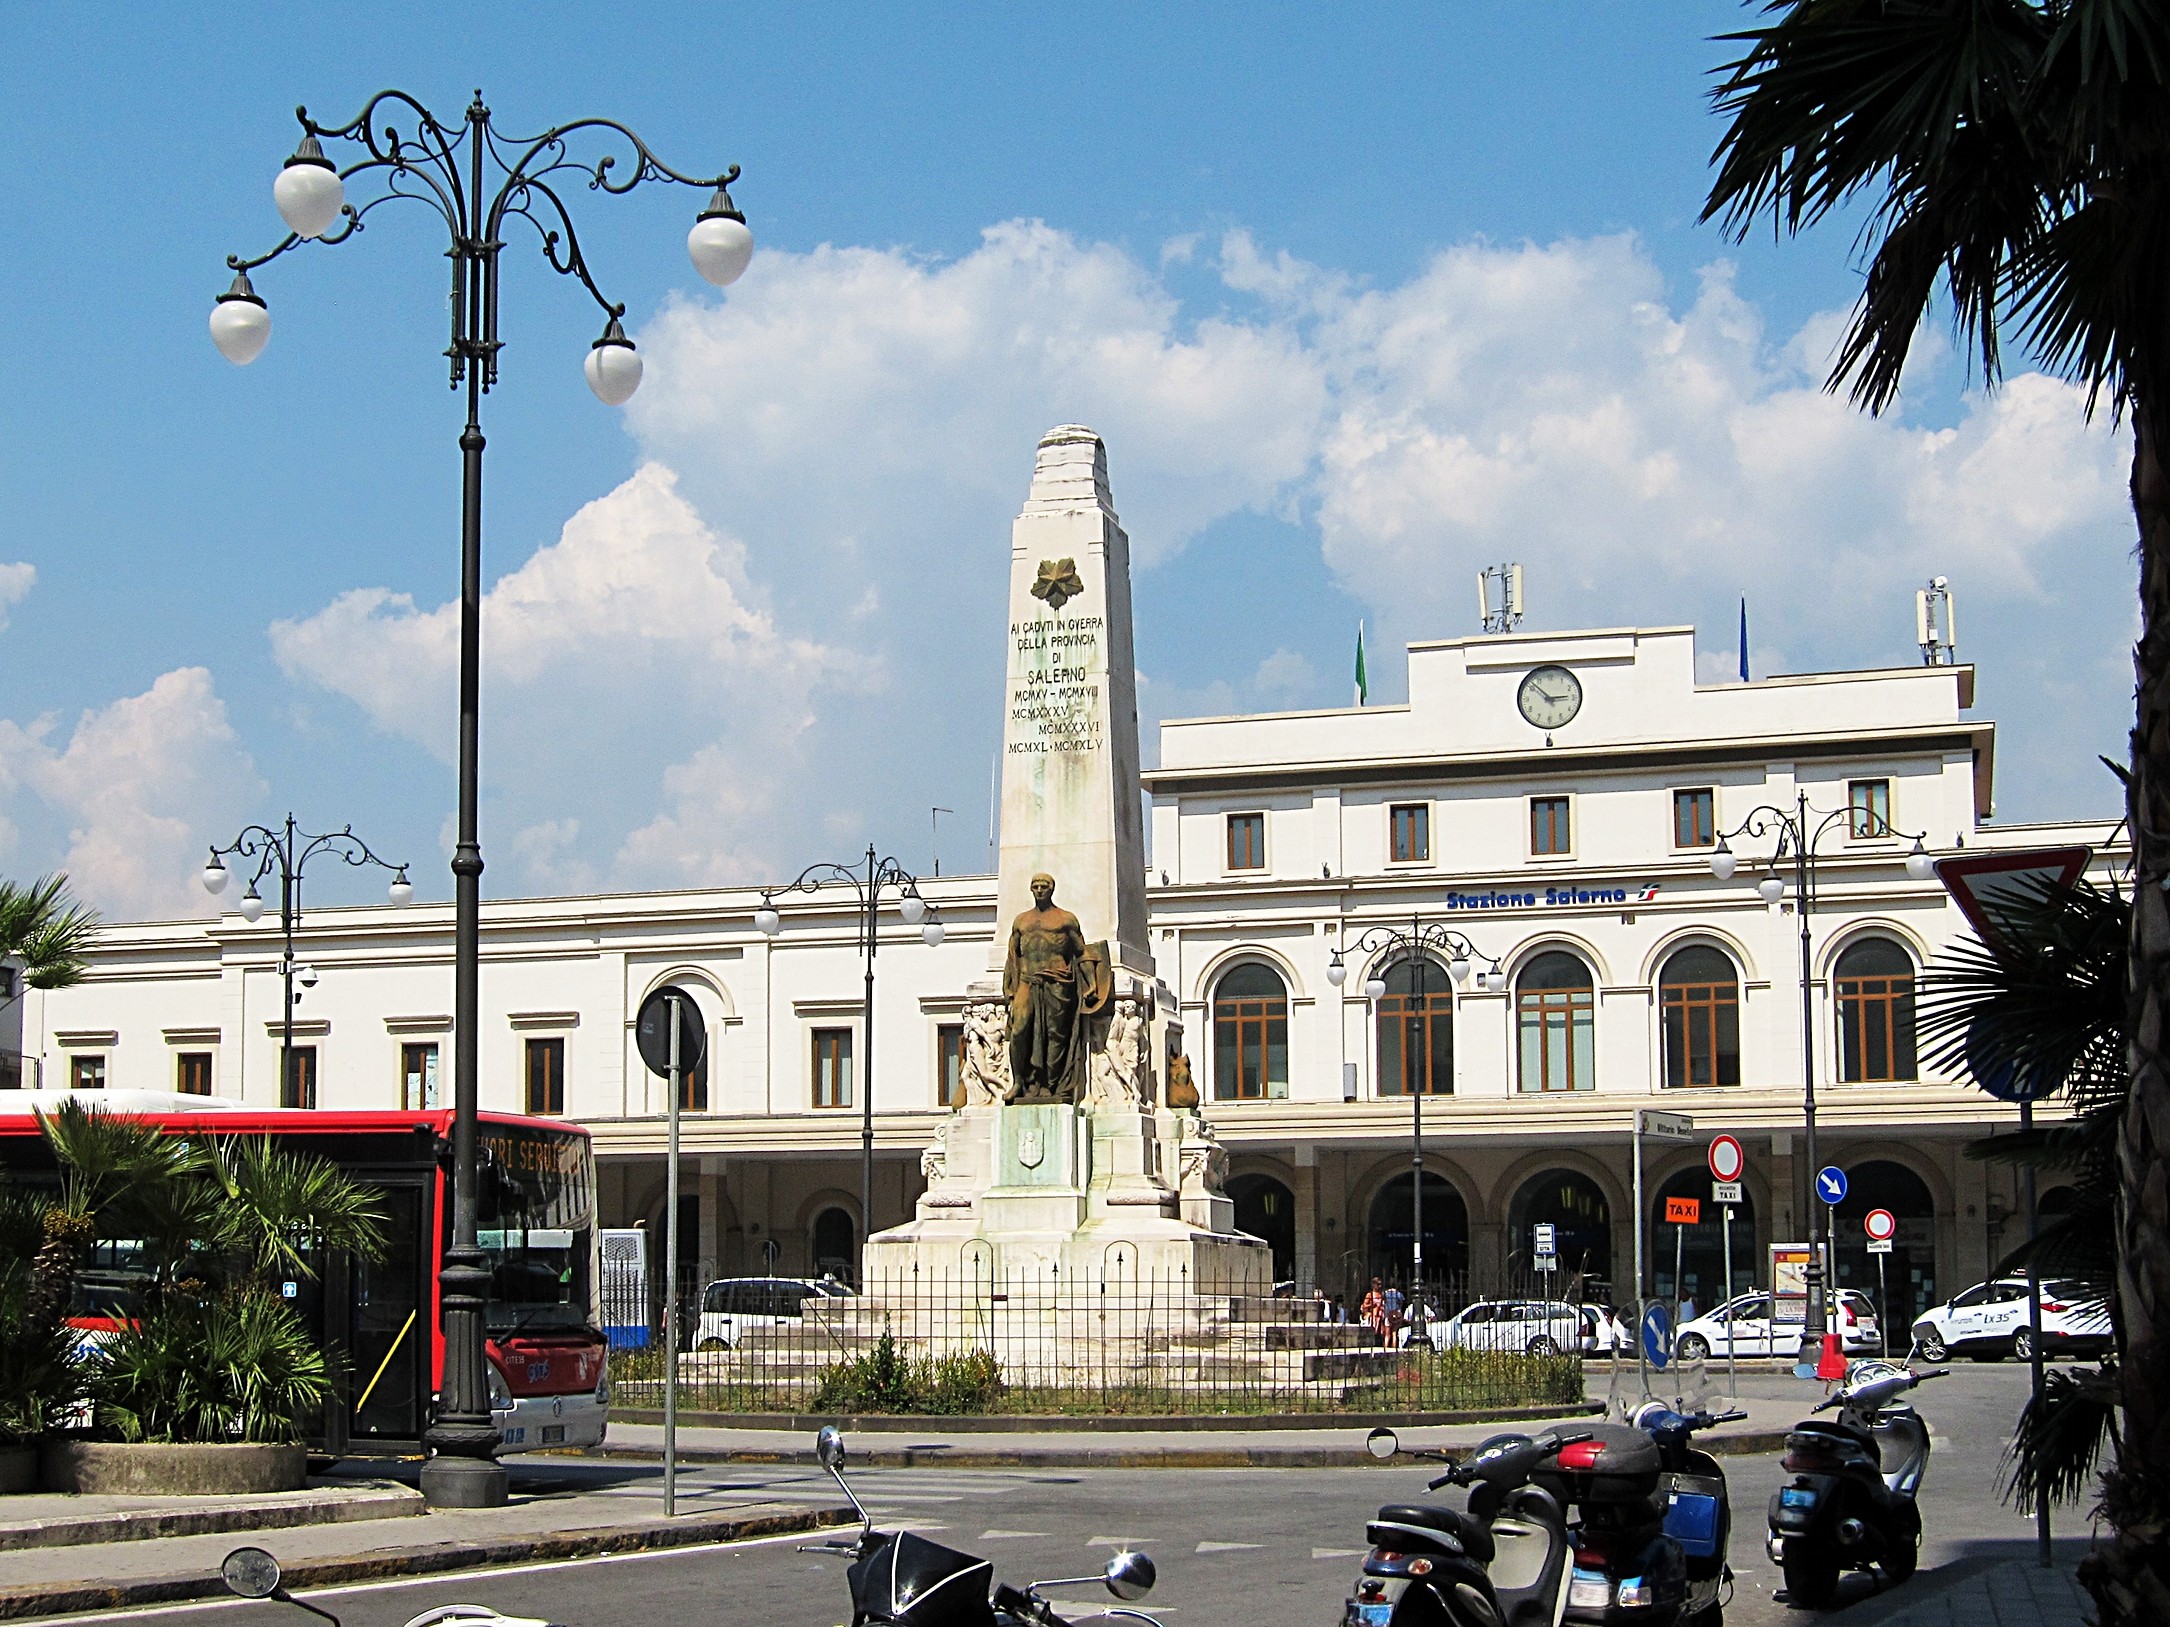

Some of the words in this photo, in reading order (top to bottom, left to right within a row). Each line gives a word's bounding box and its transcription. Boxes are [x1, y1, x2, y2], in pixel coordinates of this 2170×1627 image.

[1010, 622, 1020, 635] AI
[1057, 619, 1066, 630] IN
[1017, 637, 1048, 650] DELLA
[1051, 634, 1097, 648] PROVINCIA
[1052, 652, 1061, 663] DI
[1027, 667, 1086, 685] SALERNO
[1014, 688, 1048, 702] MCMXV
[1058, 685, 1099, 699] MCMXVIII
[1012, 706, 1069, 720] MCMXXXV
[1038, 721, 1100, 736] MCMXXXVI
[1446, 891, 1536, 910] Stazione
[1546, 886, 1627, 906] Salerno
[1669, 1204, 1697, 1217] TAXI
